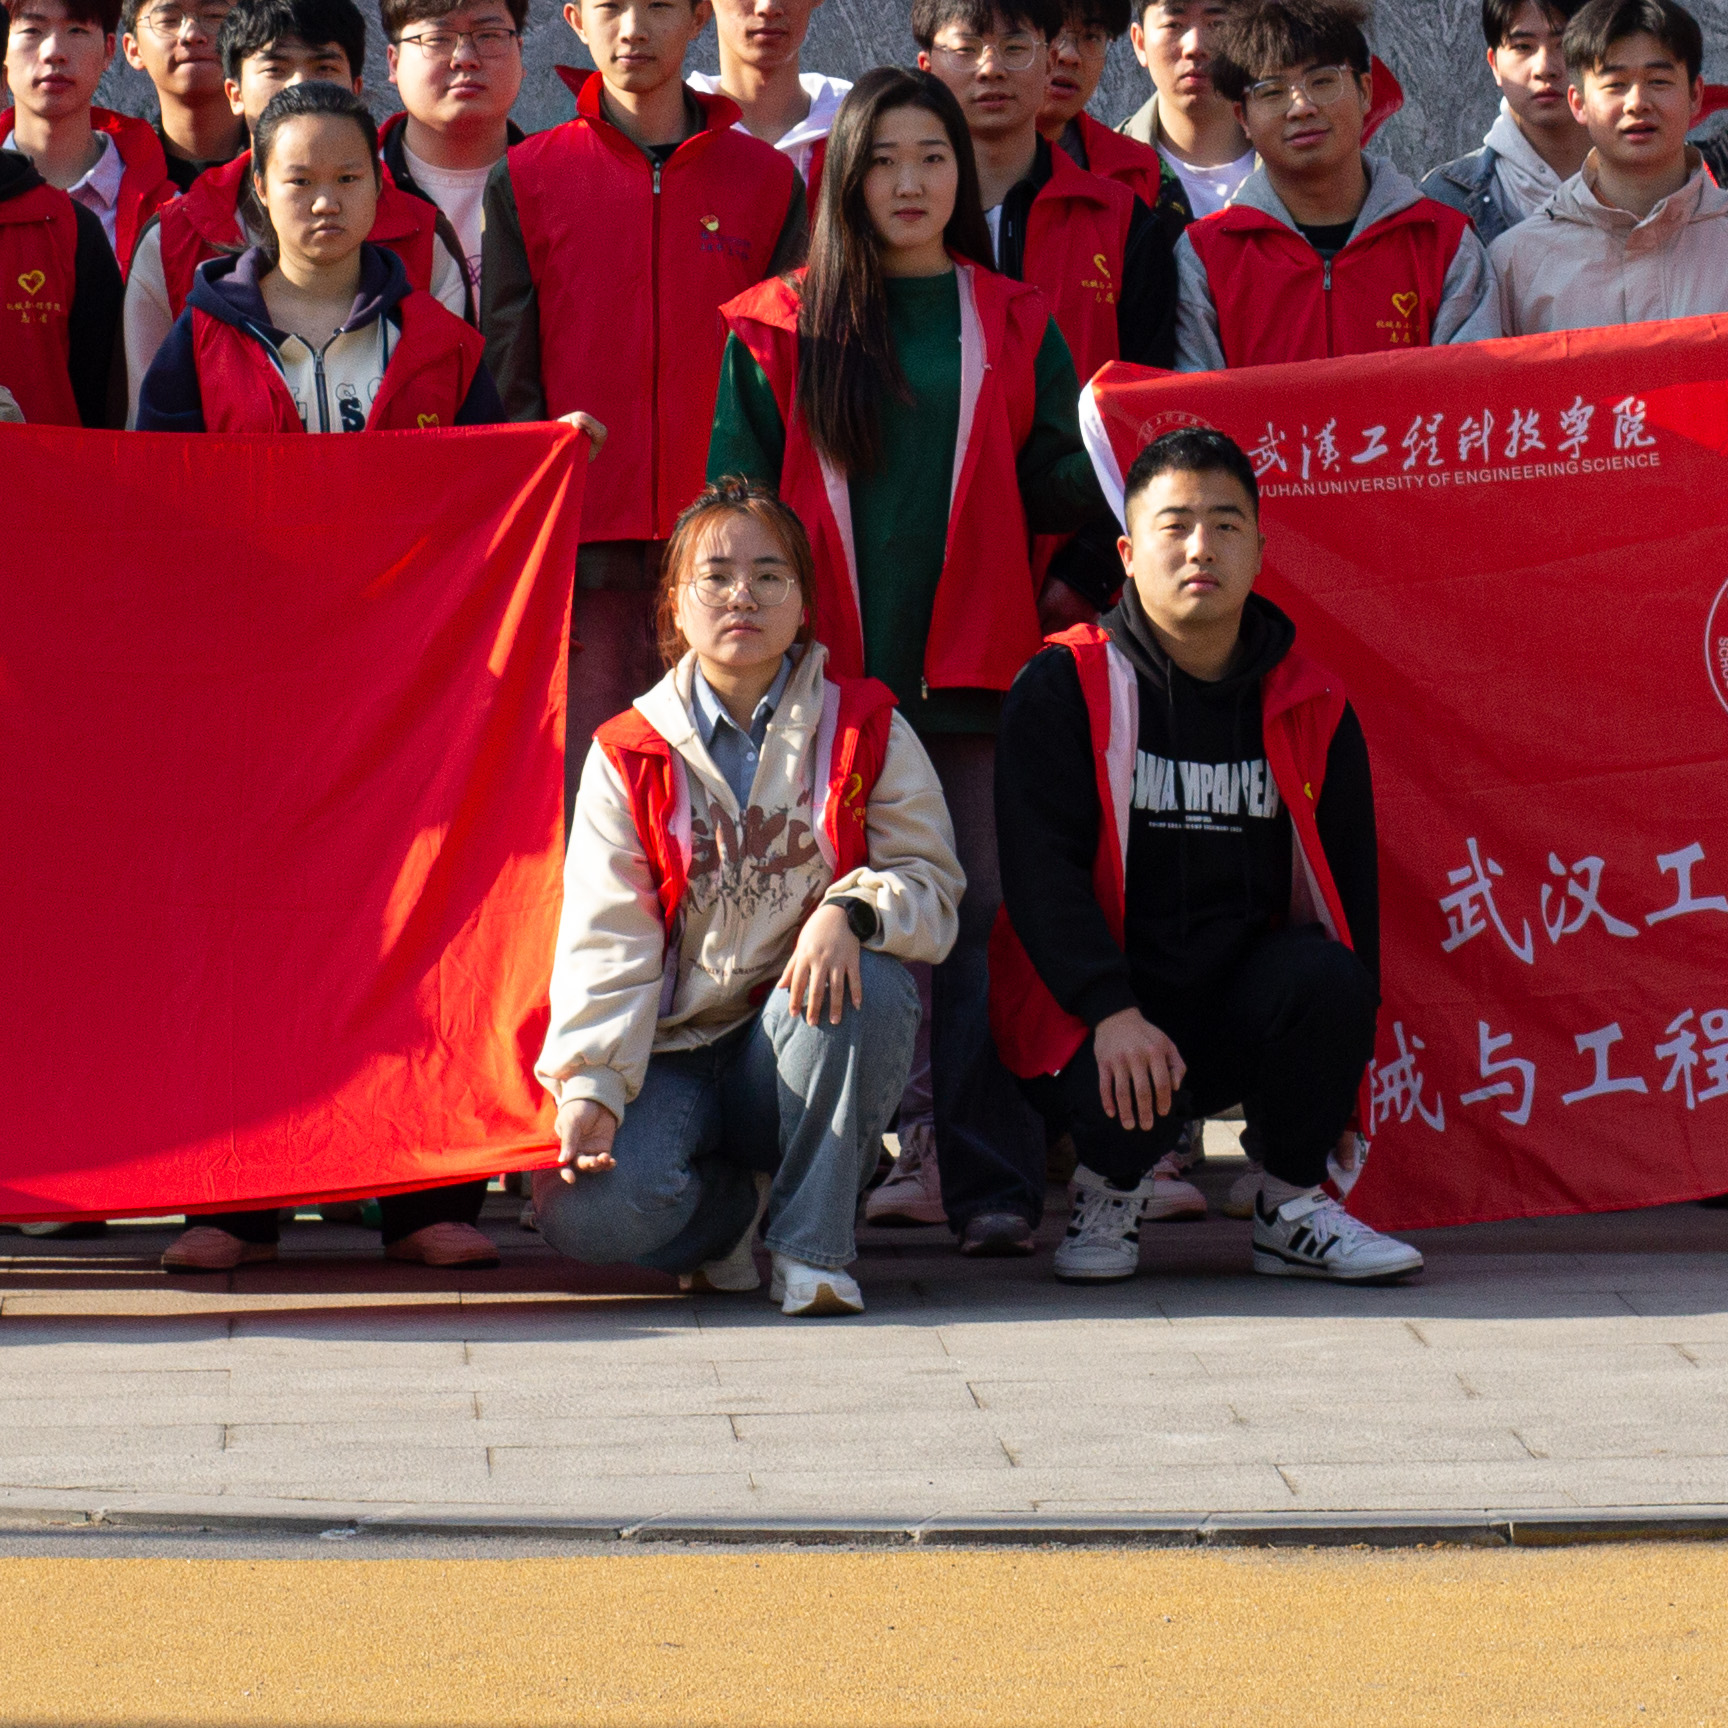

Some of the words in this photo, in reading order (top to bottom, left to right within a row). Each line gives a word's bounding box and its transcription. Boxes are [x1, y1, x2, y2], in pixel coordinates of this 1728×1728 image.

[1318, 475, 1424, 496] UNIVERSITY
[1427, 472, 1451, 488] OF
[1454, 460, 1579, 485] ENGINEERING
[1581, 452, 1661, 473] SCIENCE
